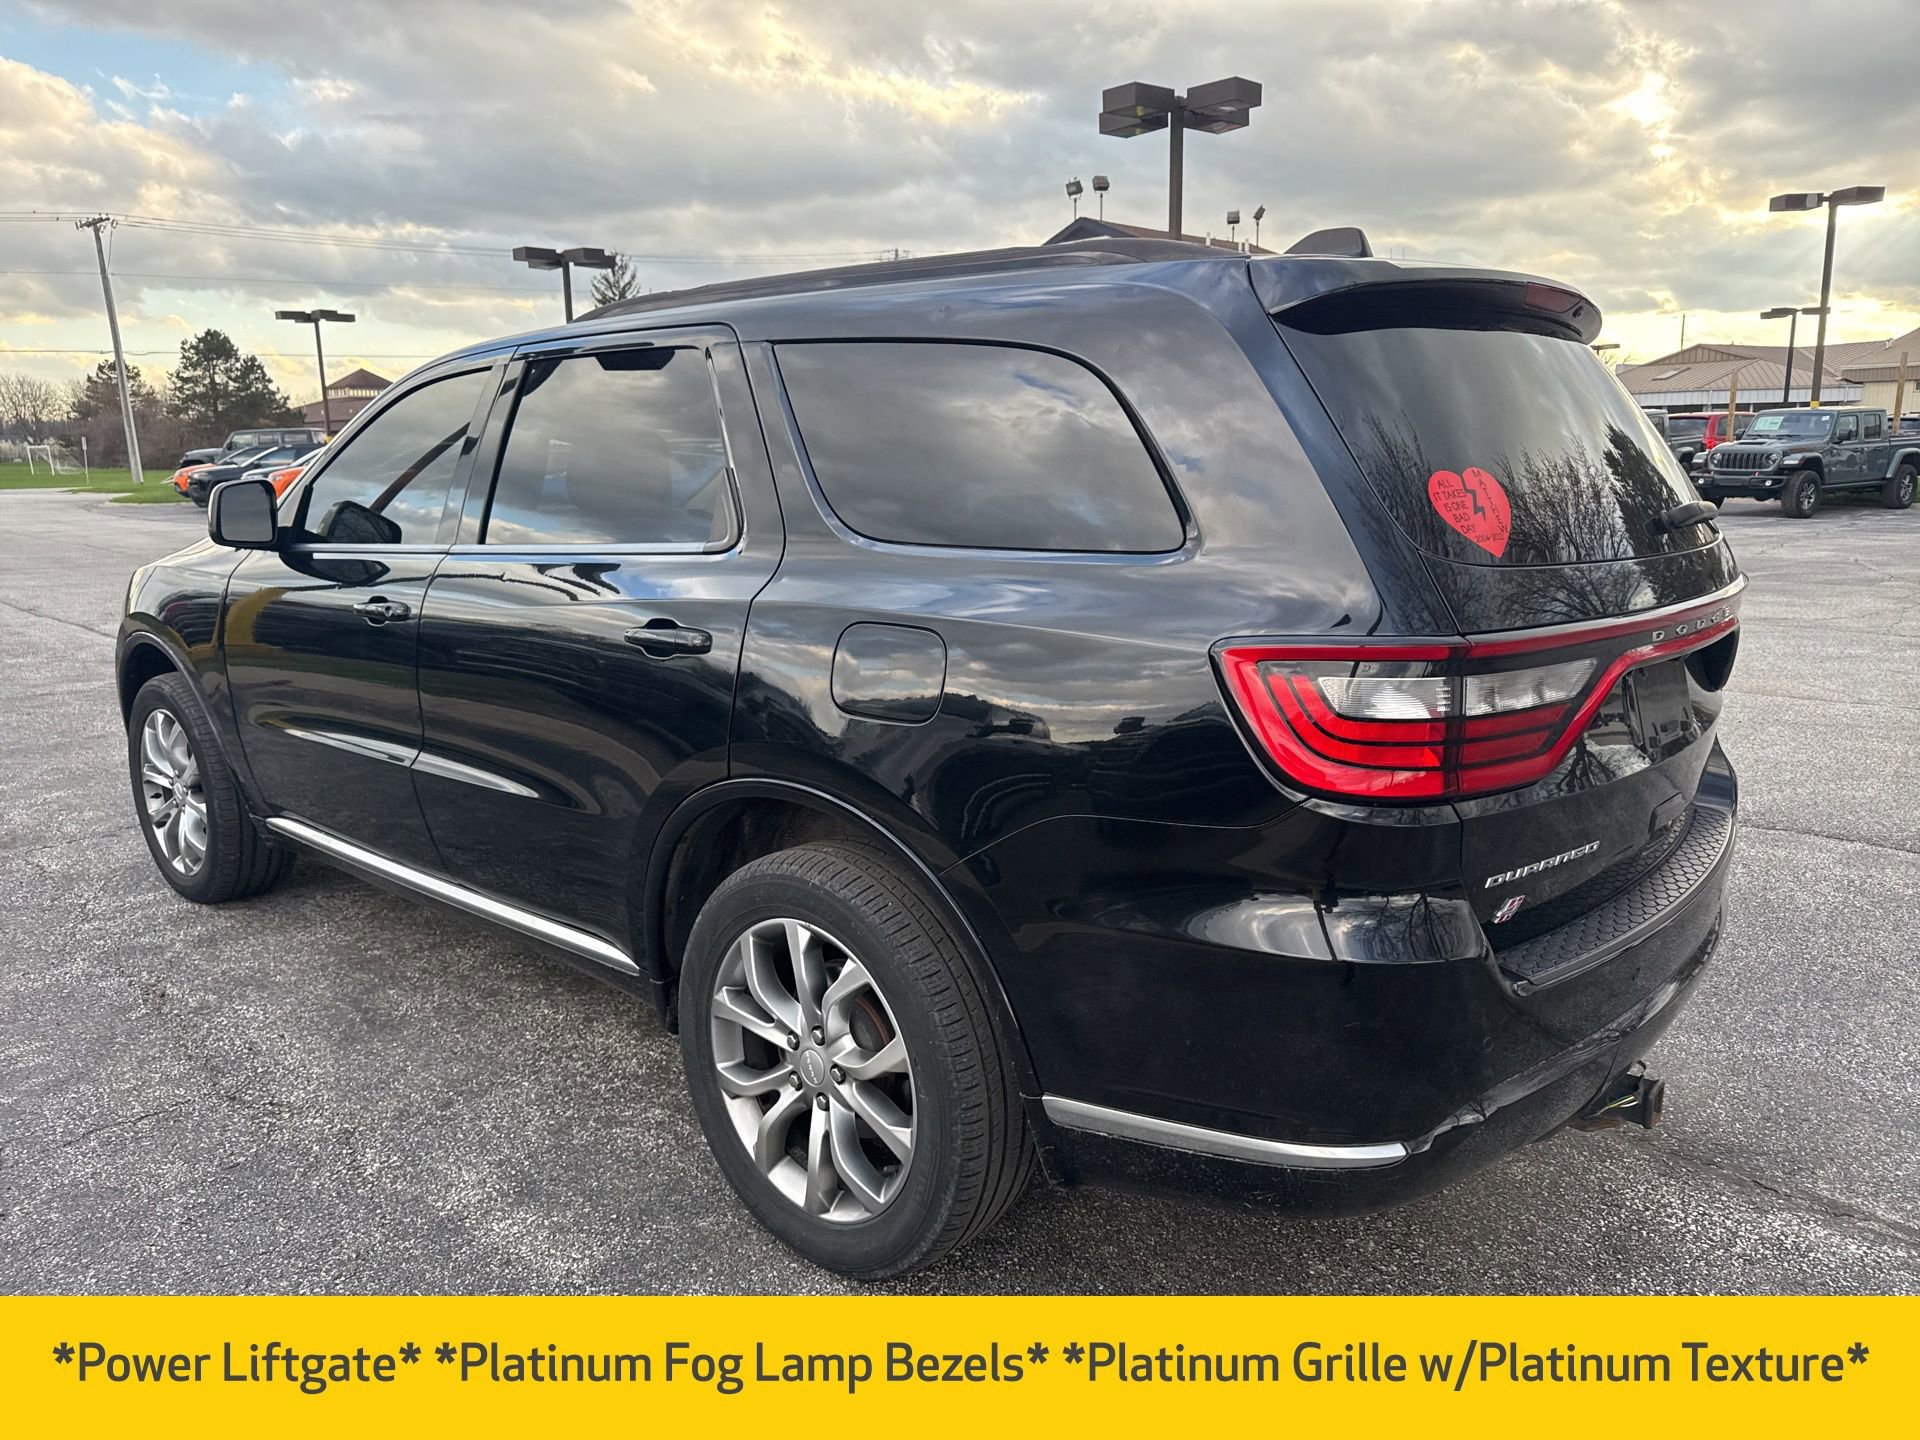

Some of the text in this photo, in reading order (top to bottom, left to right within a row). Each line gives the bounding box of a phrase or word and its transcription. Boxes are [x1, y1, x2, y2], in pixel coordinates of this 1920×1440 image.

[1438, 480, 1454, 489] ALL
[1442, 489, 1467, 499] TAKES
[1453, 513, 1471, 523] BAD
[1461, 524, 1476, 534] DAY
[1651, 605, 1731, 642] DODGE
[1485, 840, 1600, 889] DURANGO
